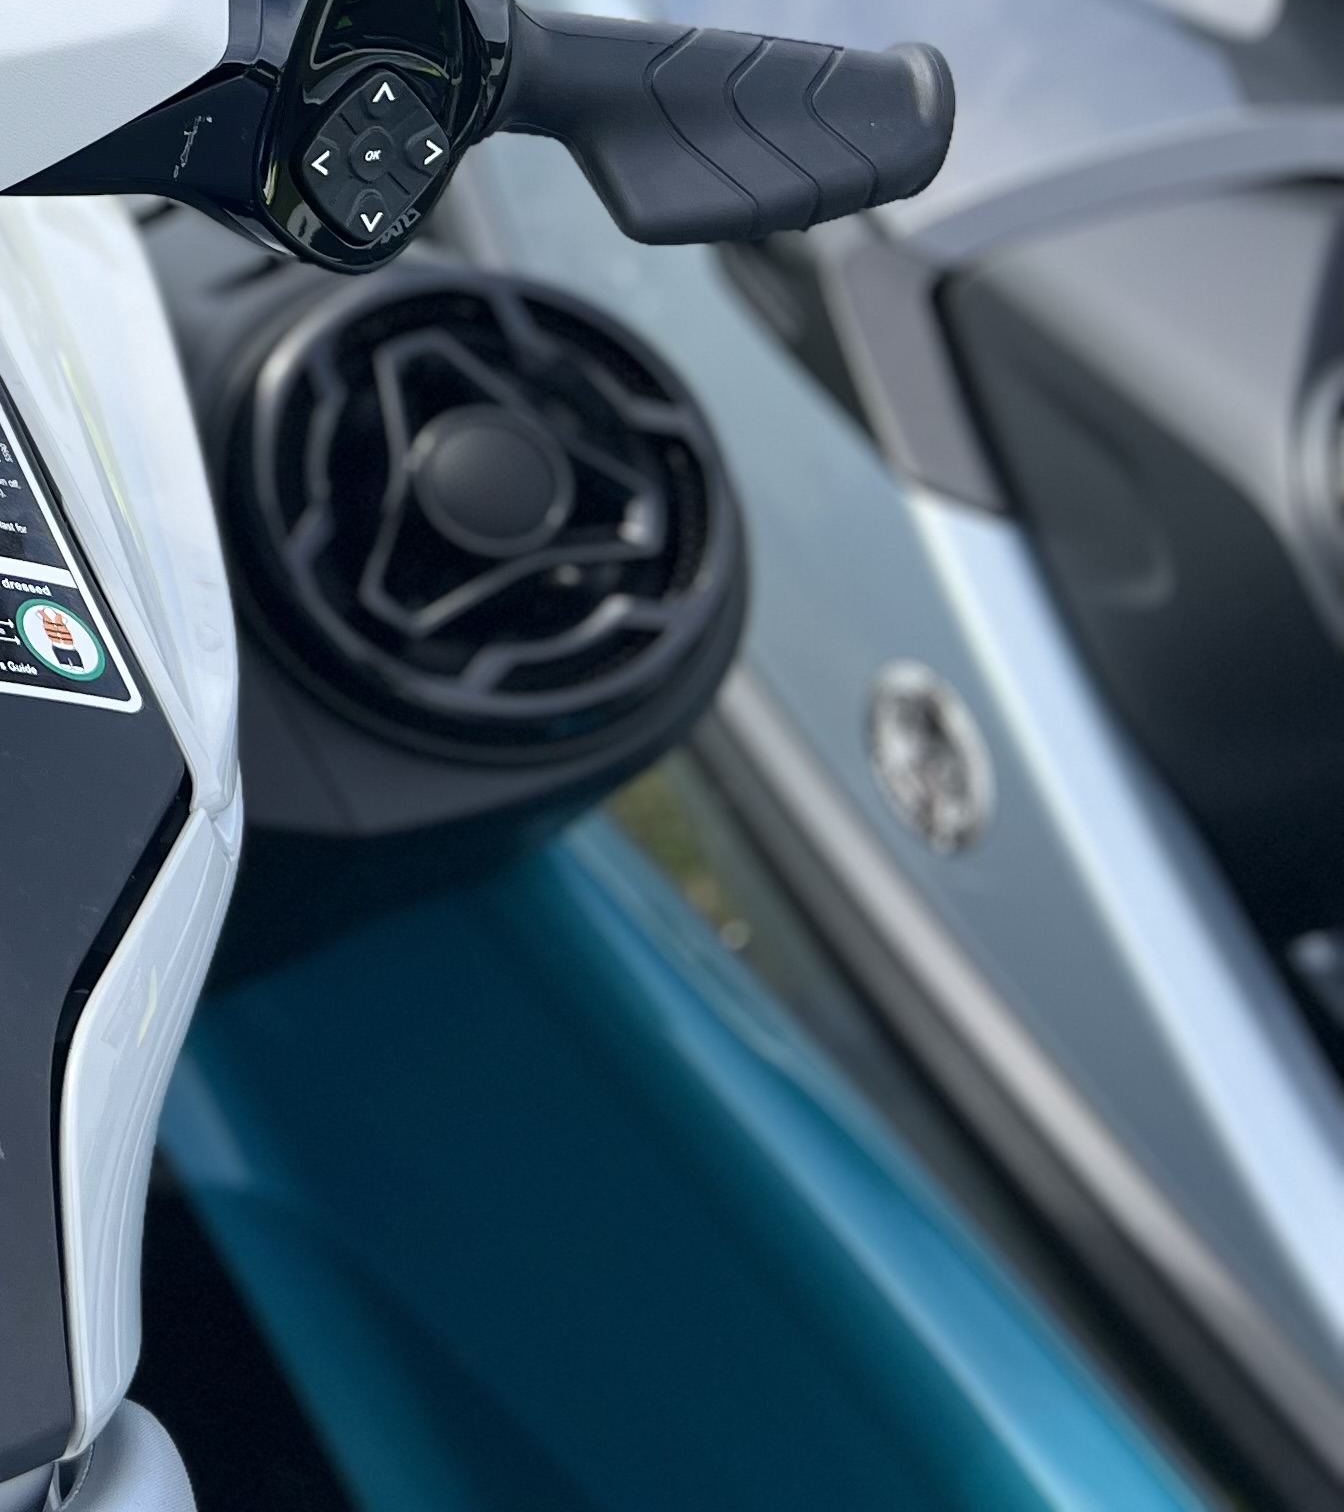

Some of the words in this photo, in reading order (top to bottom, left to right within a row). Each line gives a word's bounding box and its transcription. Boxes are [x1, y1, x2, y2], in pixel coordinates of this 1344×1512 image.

[364, 149, 382, 162] OK
[1, 577, 52, 596] dressed
[7, 659, 38, 674] Guide
